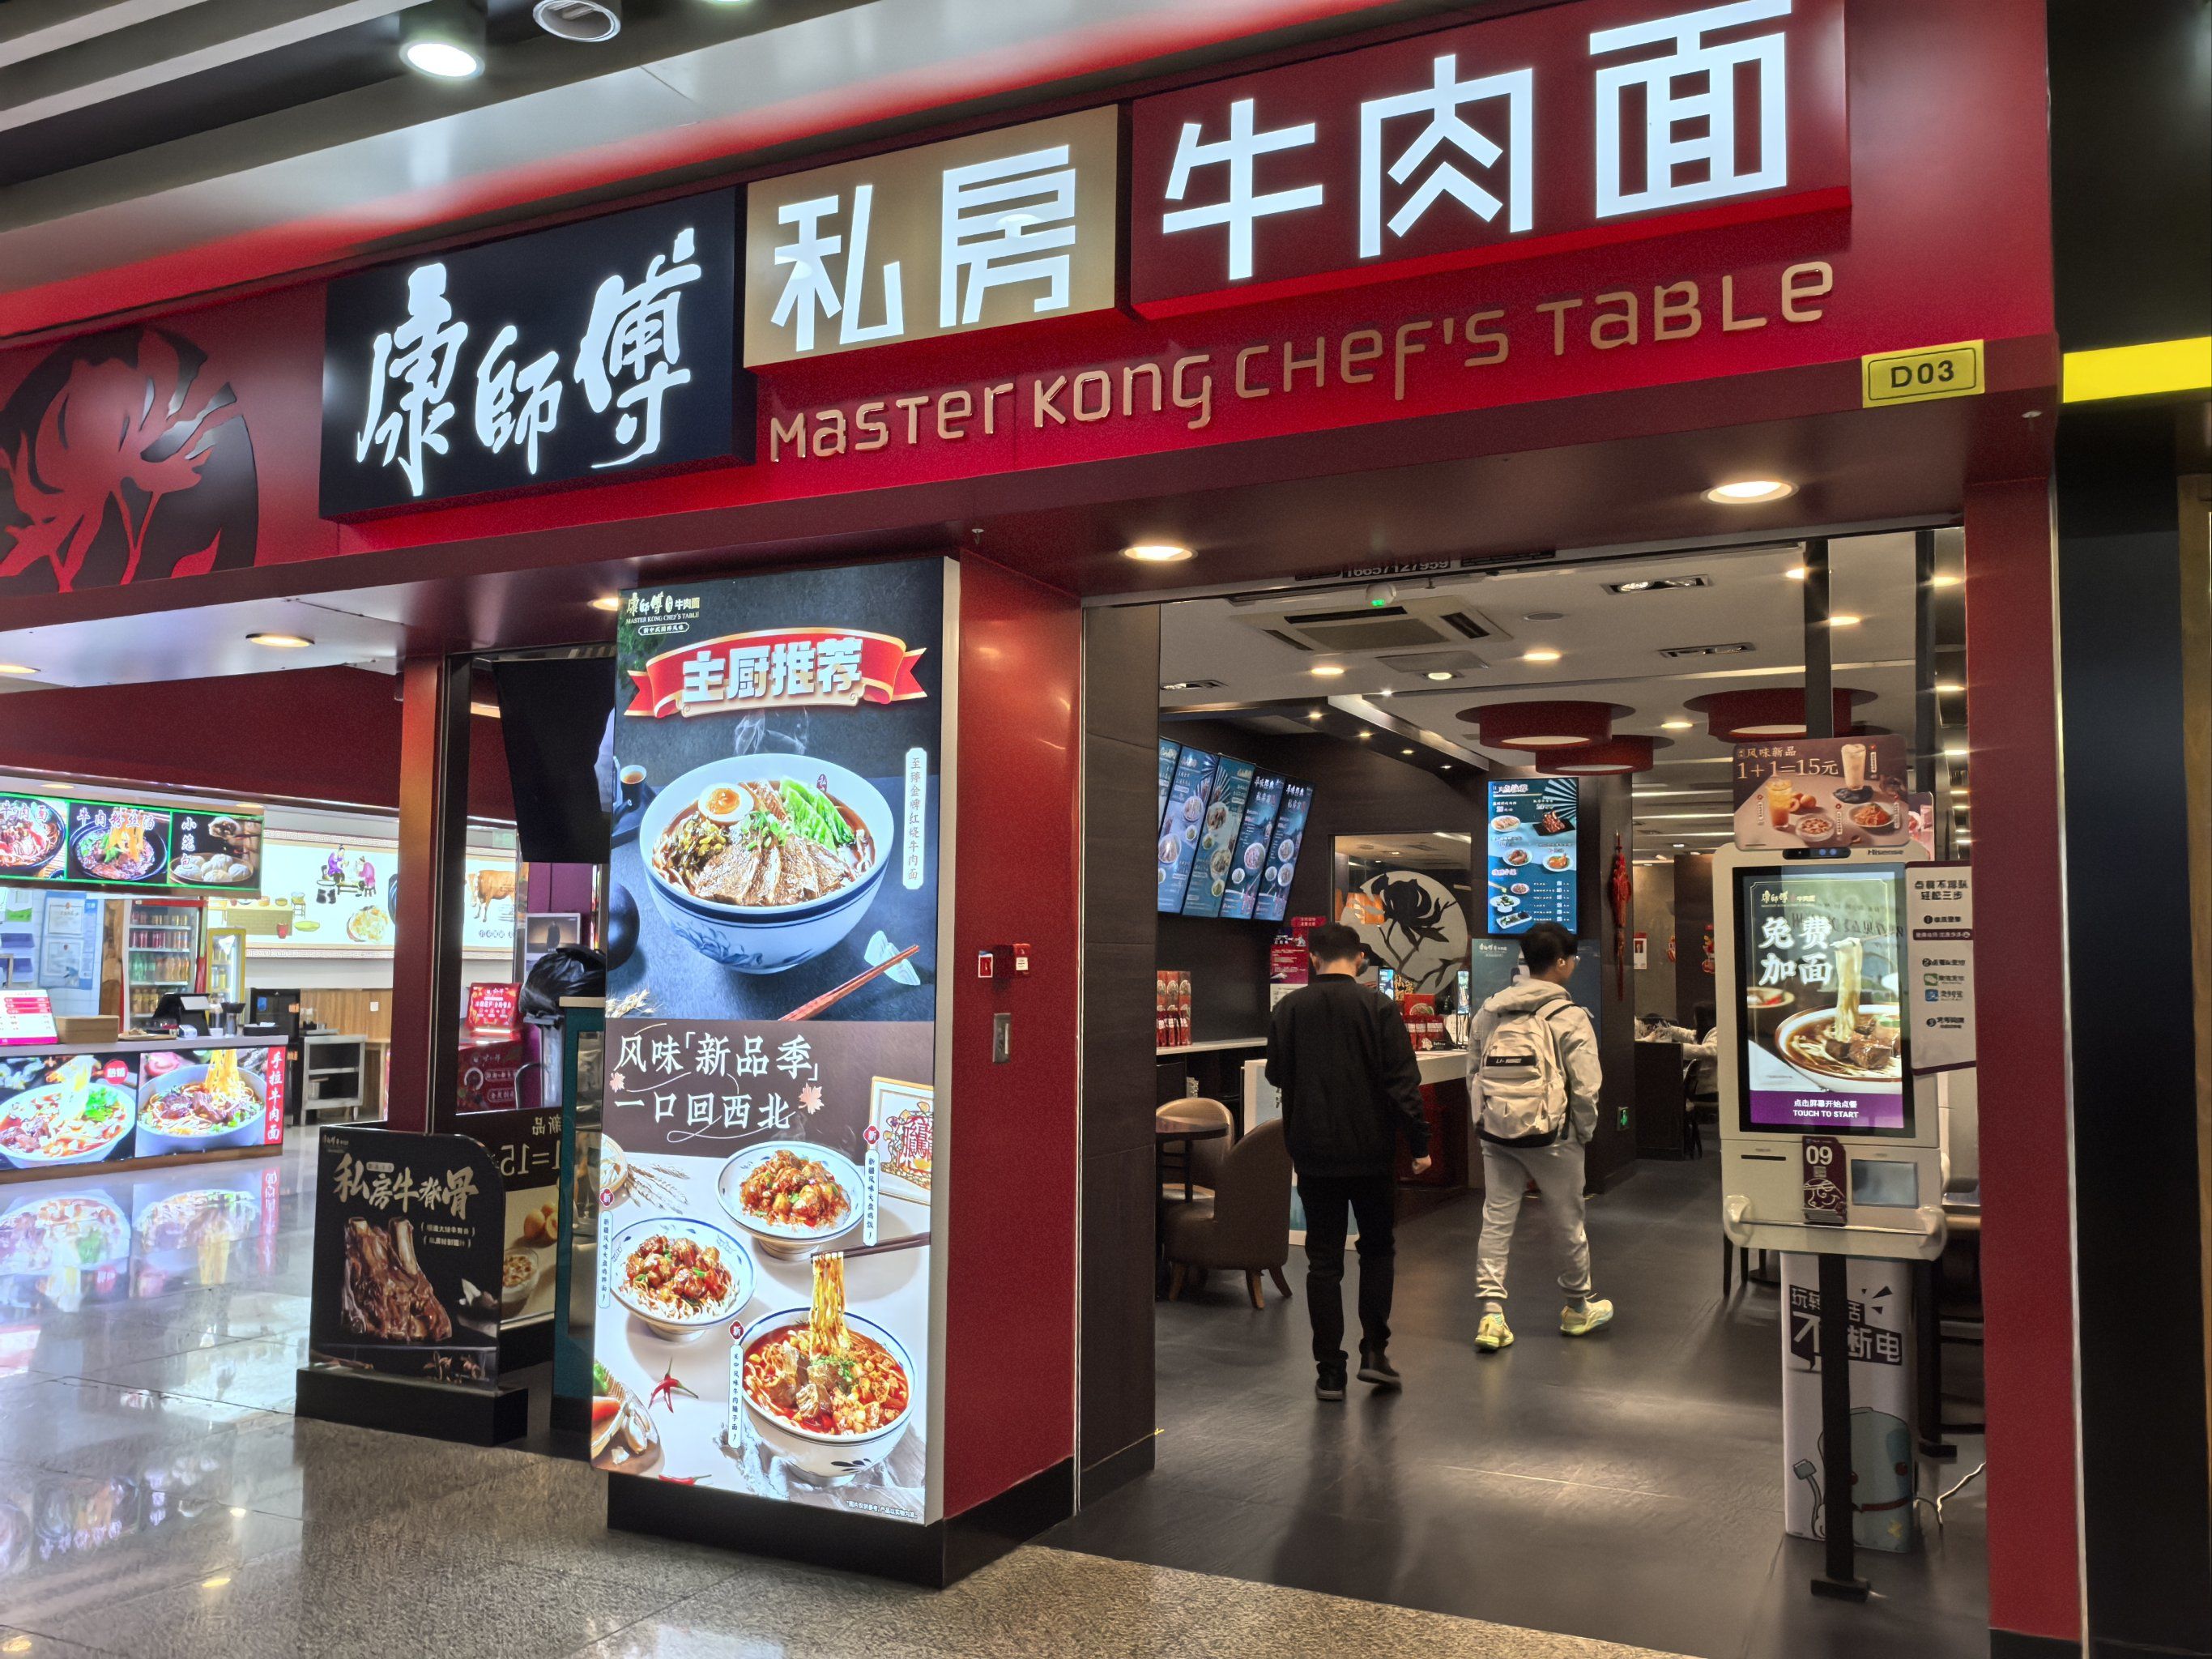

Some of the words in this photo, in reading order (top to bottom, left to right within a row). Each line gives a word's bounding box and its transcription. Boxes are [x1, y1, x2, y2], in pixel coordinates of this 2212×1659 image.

[358, 227, 700, 497] 康師傅
[771, 145, 1076, 352] 私房
[1163, 0, 1792, 280] 牛肉面
[1890, 360, 1955, 390] D03
[625, 616, 648, 625] MASTER
[648, 615, 663, 623] KONG
[682, 611, 700, 620] TABLE
[674, 597, 700, 611] 牛肉面
[681, 637, 863, 703] 主厨推荐
[1737, 757, 1839, 779] 1+1=15元
[181, 817, 198, 871] 小笼包
[1758, 915, 1832, 949] 免费
[1758, 953, 1833, 986] 加面
[613, 1031, 820, 1081] 风味「新品季」
[266, 1051, 283, 1141] 手拉牛肉面
[614, 1091, 791, 1131] 一口回西北
[1793, 1098, 1857, 1109] 点击屏幕开始点餐
[1792, 1109, 1820, 1118] TOUCH
[1822, 1110, 1832, 1118] TO
[1833, 1110, 1859, 1119] START
[1806, 1145, 1833, 1166] 09
